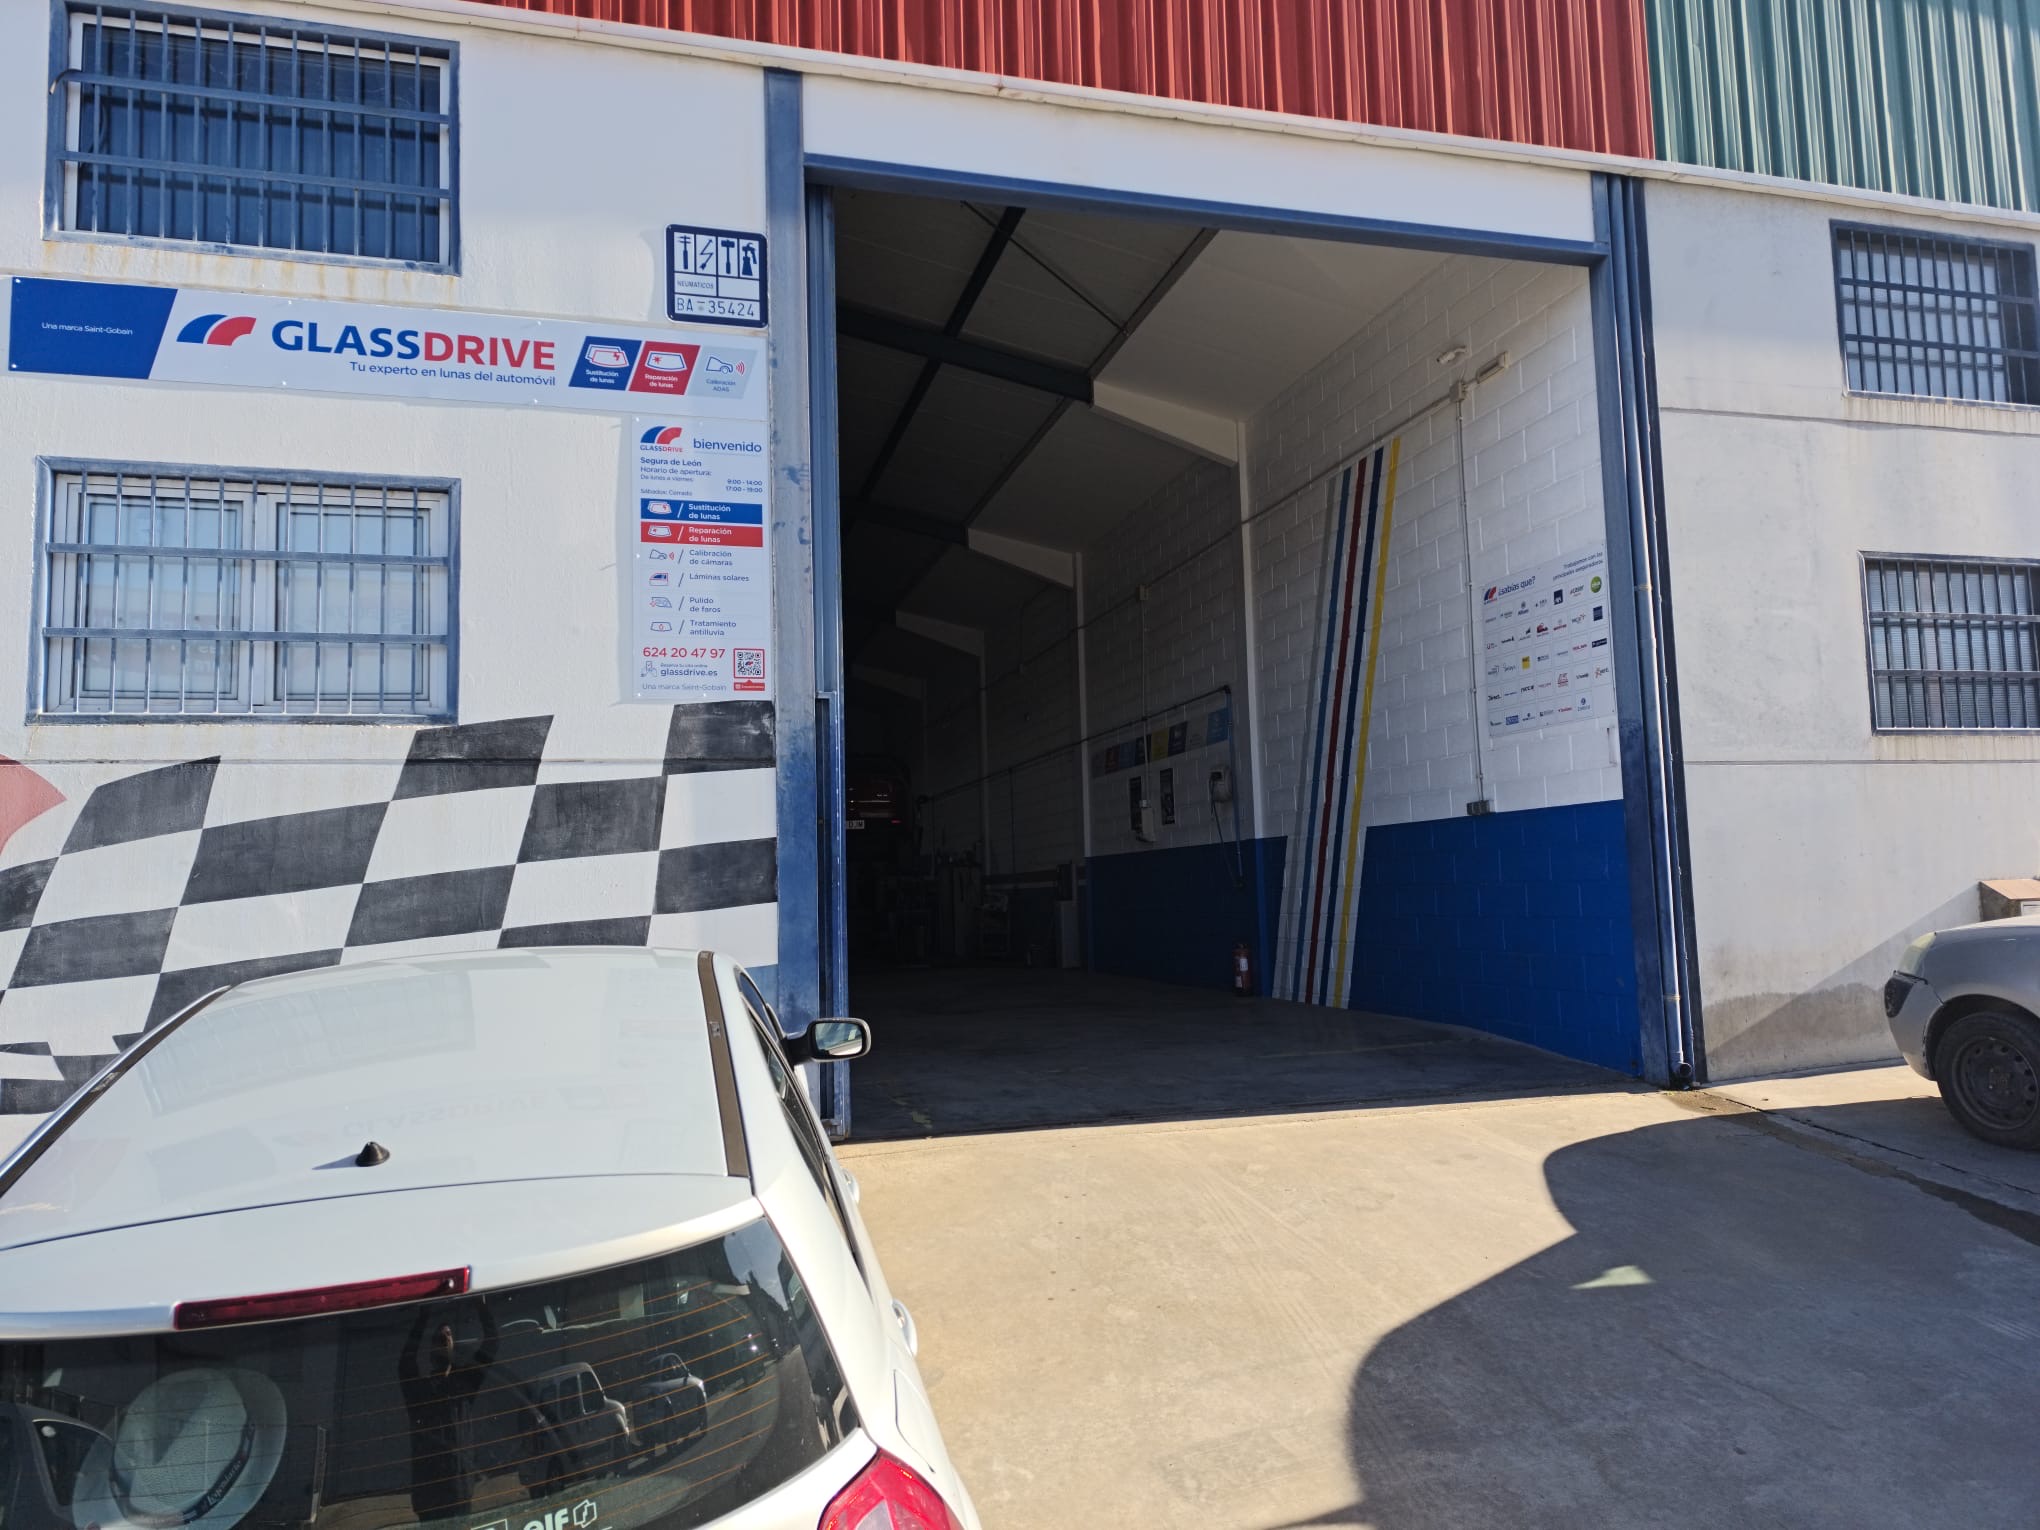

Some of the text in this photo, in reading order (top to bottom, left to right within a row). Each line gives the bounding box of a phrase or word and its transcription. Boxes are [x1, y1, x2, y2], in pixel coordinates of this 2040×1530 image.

[41, 321, 133, 336] Una marca Saint-Gobain
[271, 320, 556, 371] GLASSDRIVE
[349, 361, 556, 386] Tu experto en lunas del automóvil
[585, 368, 619, 378] Sustitución
[644, 373, 678, 383] Reparación
[712, 385, 730, 393] ADAS
[640, 444, 683, 453] GLASSDRIVE
[693, 438, 762, 453] bienvenido
[640, 457, 702, 467] Segura de León
[640, 466, 668, 474] Horario
[680, 469, 712, 477] apertura:
[688, 503, 731, 512] Sustitución
[689, 526, 732, 536] Reparación
[689, 549, 732, 557] Calibración
[722, 574, 750, 582] solares
[689, 596, 714, 604] Pulido
[690, 620, 736, 628] Tratamiento
[643, 646, 726, 659] 624 20 47 97
[660, 668, 718, 677] glassdrive.es
